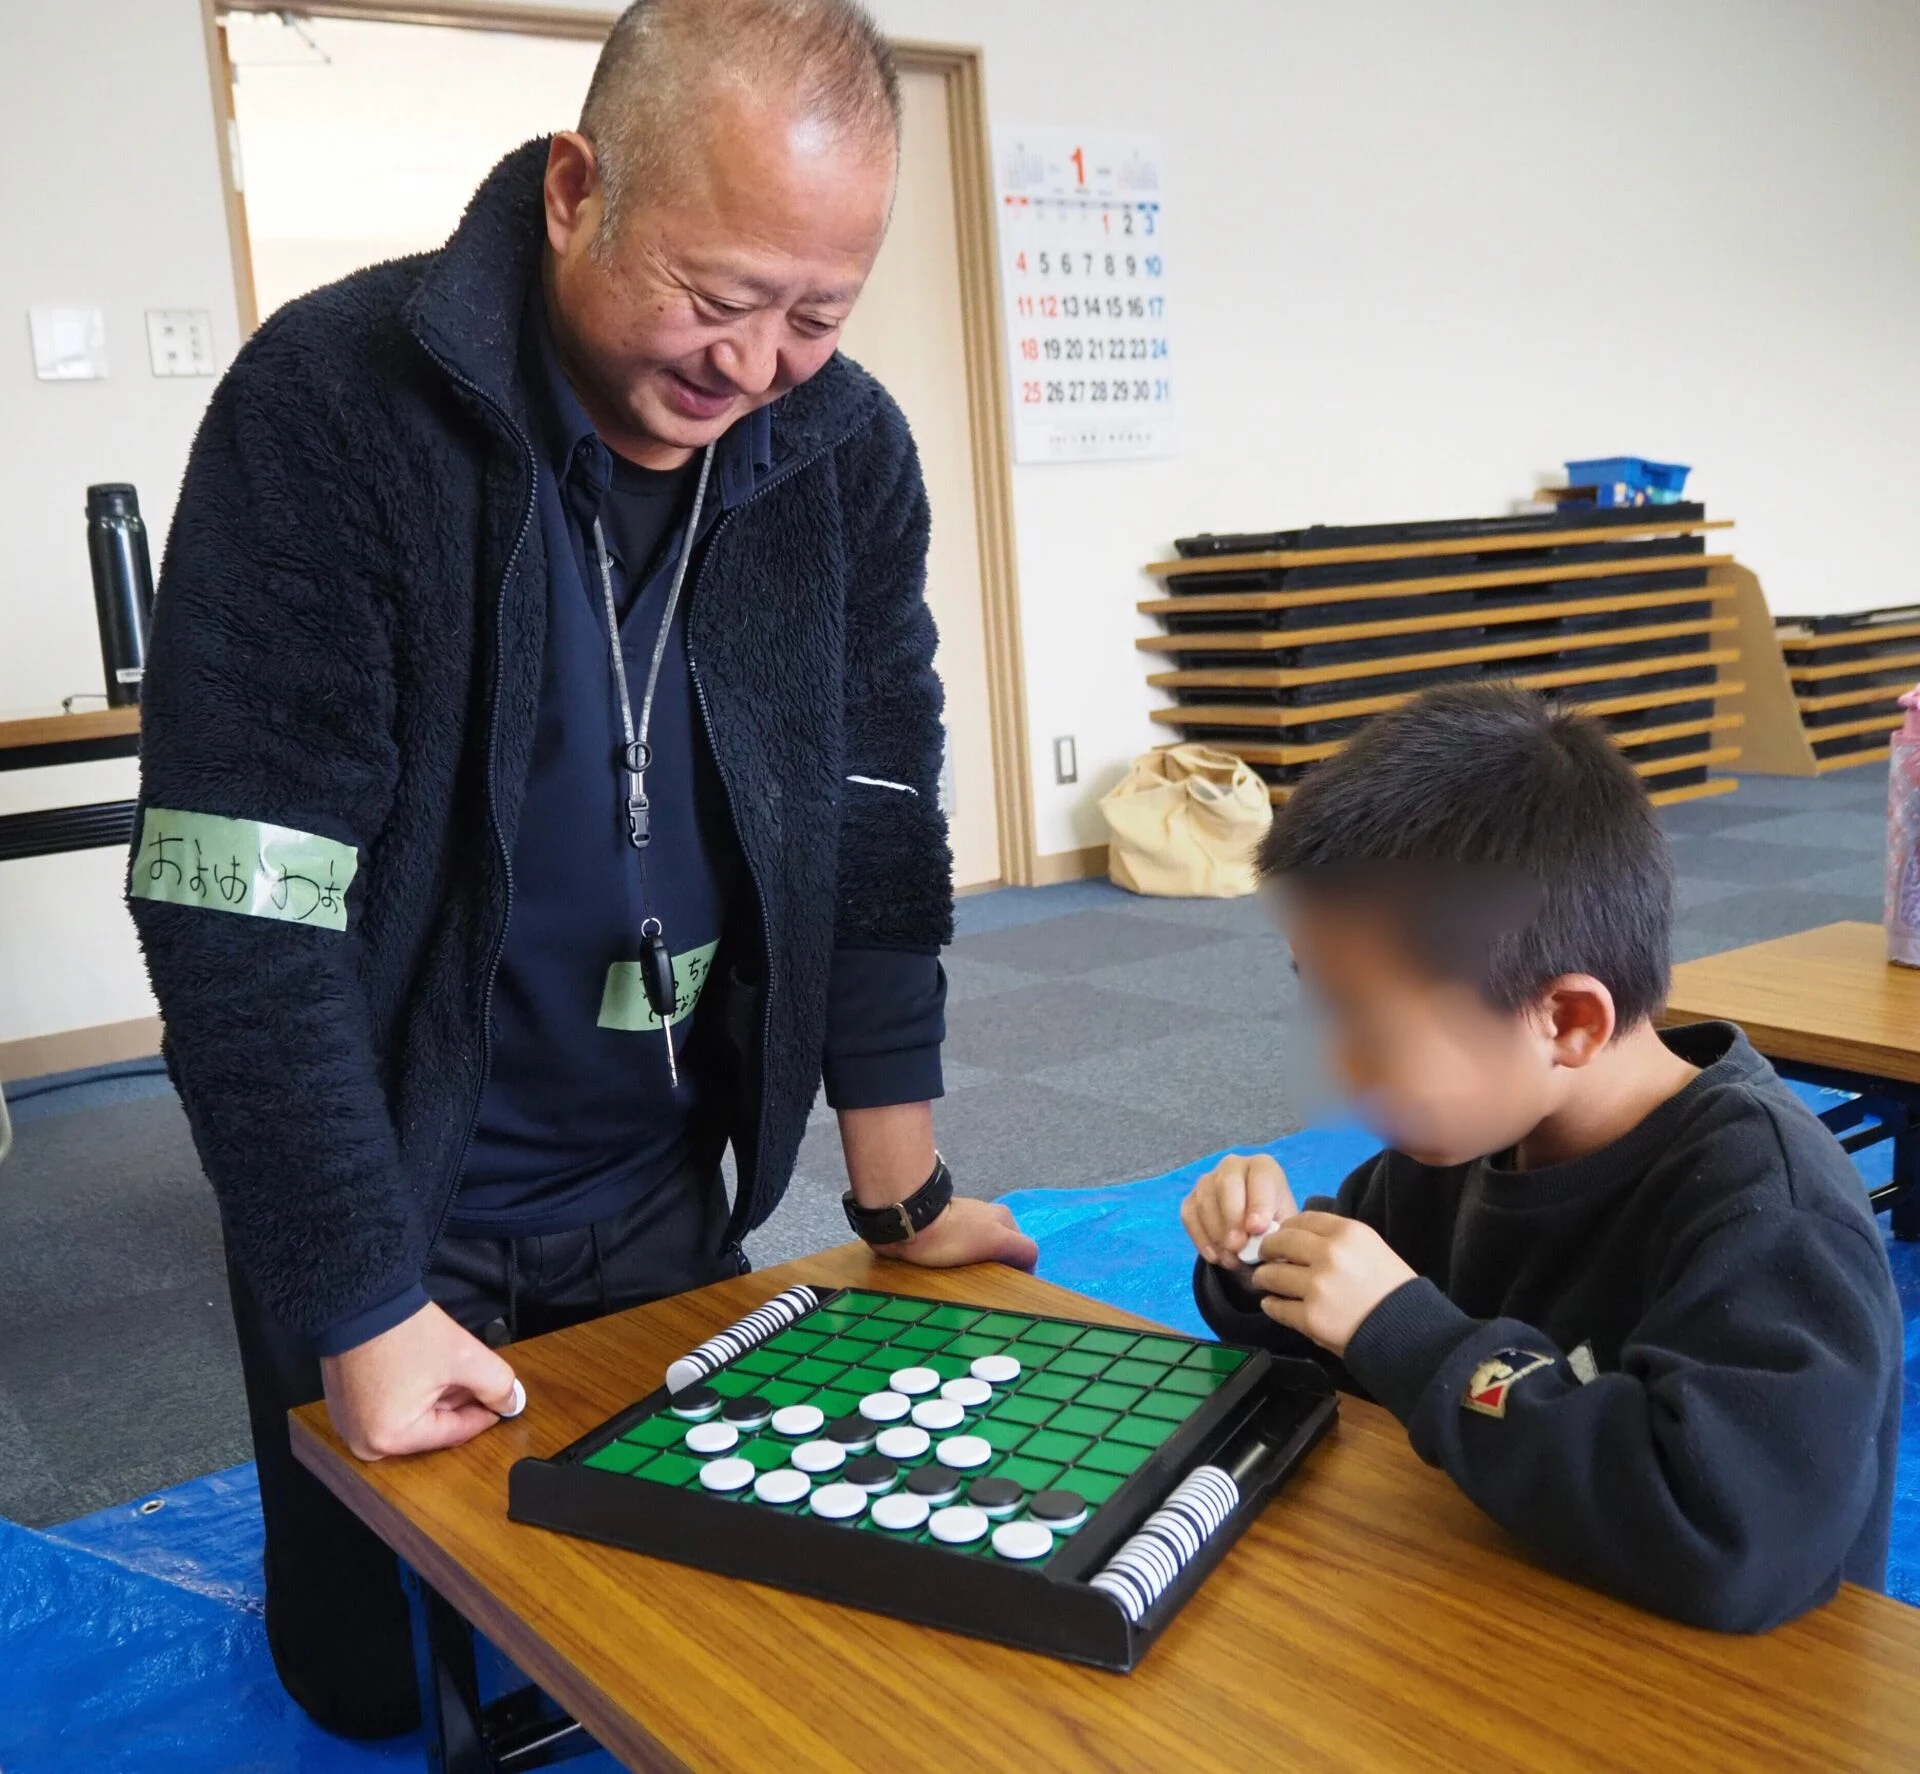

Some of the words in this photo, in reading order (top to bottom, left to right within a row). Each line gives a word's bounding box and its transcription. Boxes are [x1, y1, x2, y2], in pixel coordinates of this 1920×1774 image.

[1070, 146, 1085, 186] 1
[1102, 212, 1110, 234] 1
[1123, 213, 1133, 235] 2
[1144, 213, 1154, 236] 3
[1016, 251, 1027, 272] 4
[1039, 251, 1050, 274] 5
[1061, 252, 1072, 275] 6
[1084, 252, 1093, 275] 7
[1104, 254, 1115, 276] 8
[1125, 255, 1136, 276] 9
[1145, 255, 1162, 276] 10
[1018, 296, 1033, 317] 11
[1040, 296, 1057, 318] 12
[1062, 296, 1079, 318] 13
[1084, 296, 1100, 318] 14
[1106, 296, 1122, 318] 15
[1127, 296, 1144, 317] 16
[1149, 296, 1163, 317] 17
[1021, 337, 1038, 360] 18
[1044, 338, 1060, 360] 19
[1065, 338, 1083, 359] 20
[1088, 338, 1104, 359] 21
[1109, 338, 1126, 359] 22
[1130, 338, 1147, 359] 23
[1151, 338, 1168, 359] 24
[1023, 381, 1041, 403] 25
[1047, 381, 1064, 403] 26
[1068, 381, 1085, 403] 27
[1090, 380, 1108, 402] 28
[1112, 380, 1129, 401] 29
[1132, 380, 1149, 401] 30
[1154, 380, 1169, 401] 31
